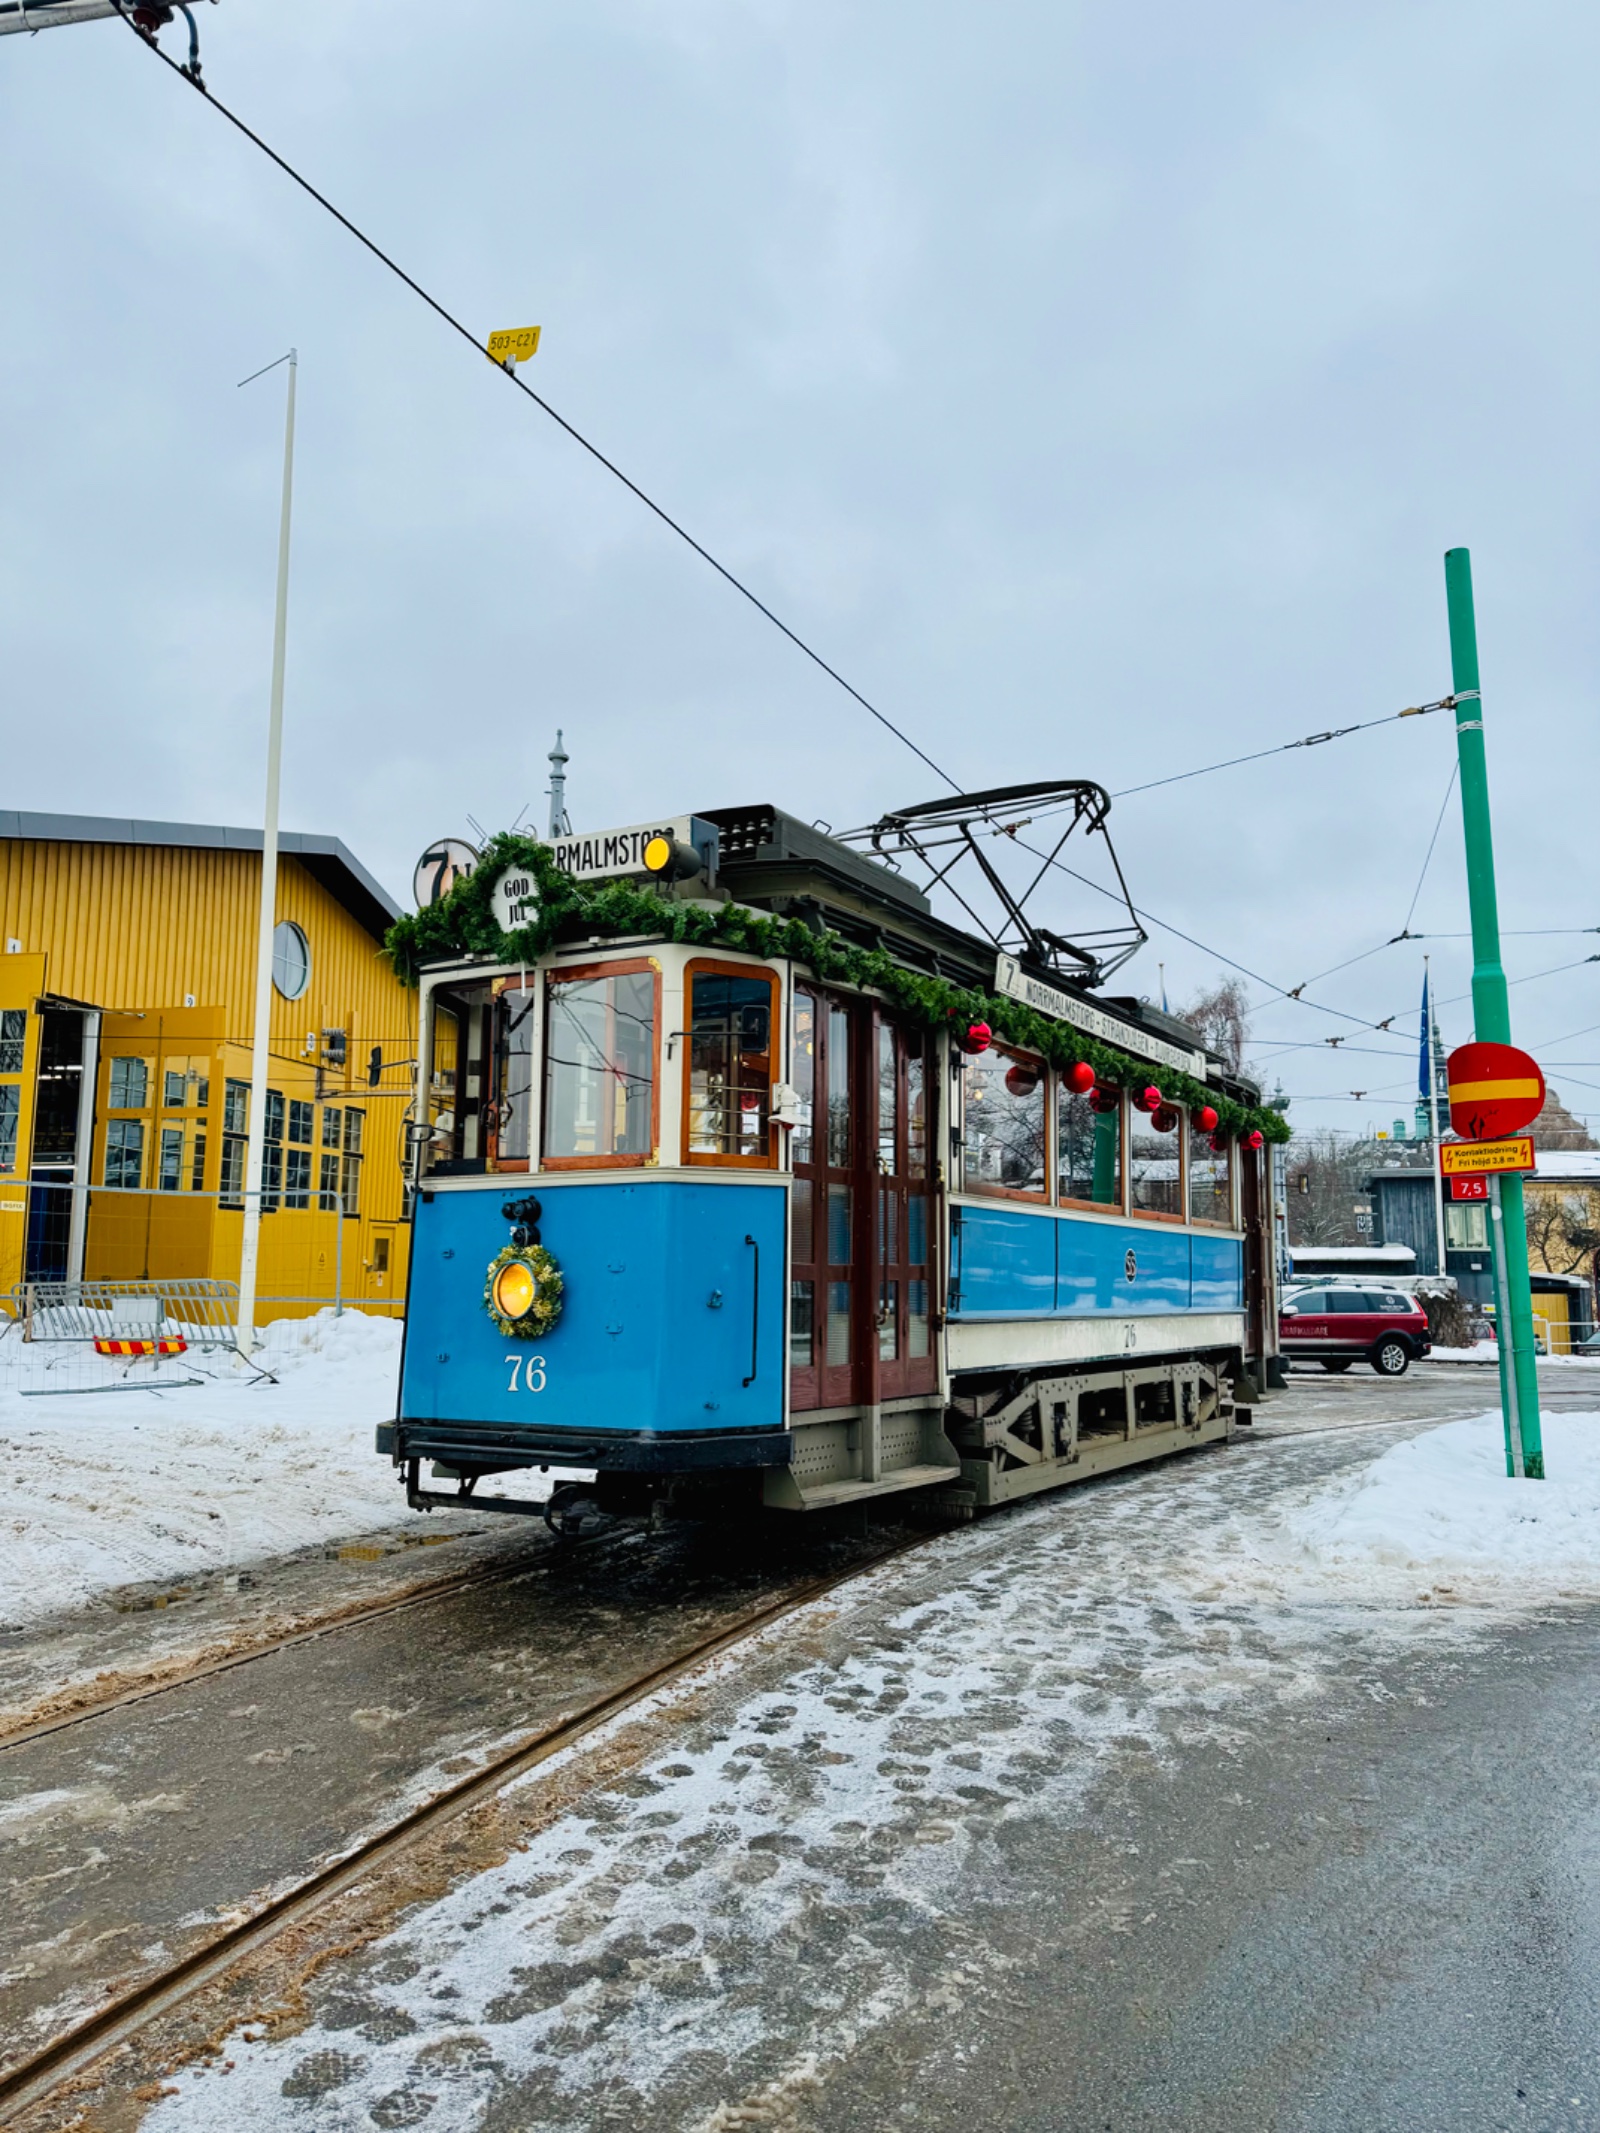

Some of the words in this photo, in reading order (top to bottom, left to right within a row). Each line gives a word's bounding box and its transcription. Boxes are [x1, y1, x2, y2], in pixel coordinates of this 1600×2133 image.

[490, 332, 536, 350] 503-C21
[504, 878, 529, 898] GOD
[509, 904, 528, 925] JUL
[1006, 962, 1015, 990] 7
[1455, 1146, 1518, 1157] Kontaktledning
[1459, 1159, 1470, 1167] Fri
[1472, 1158, 1491, 1166] höjd
[1461, 1182, 1482, 1197] 7,5
[1125, 1324, 1136, 1348] 76
[504, 1355, 547, 1392] 76
